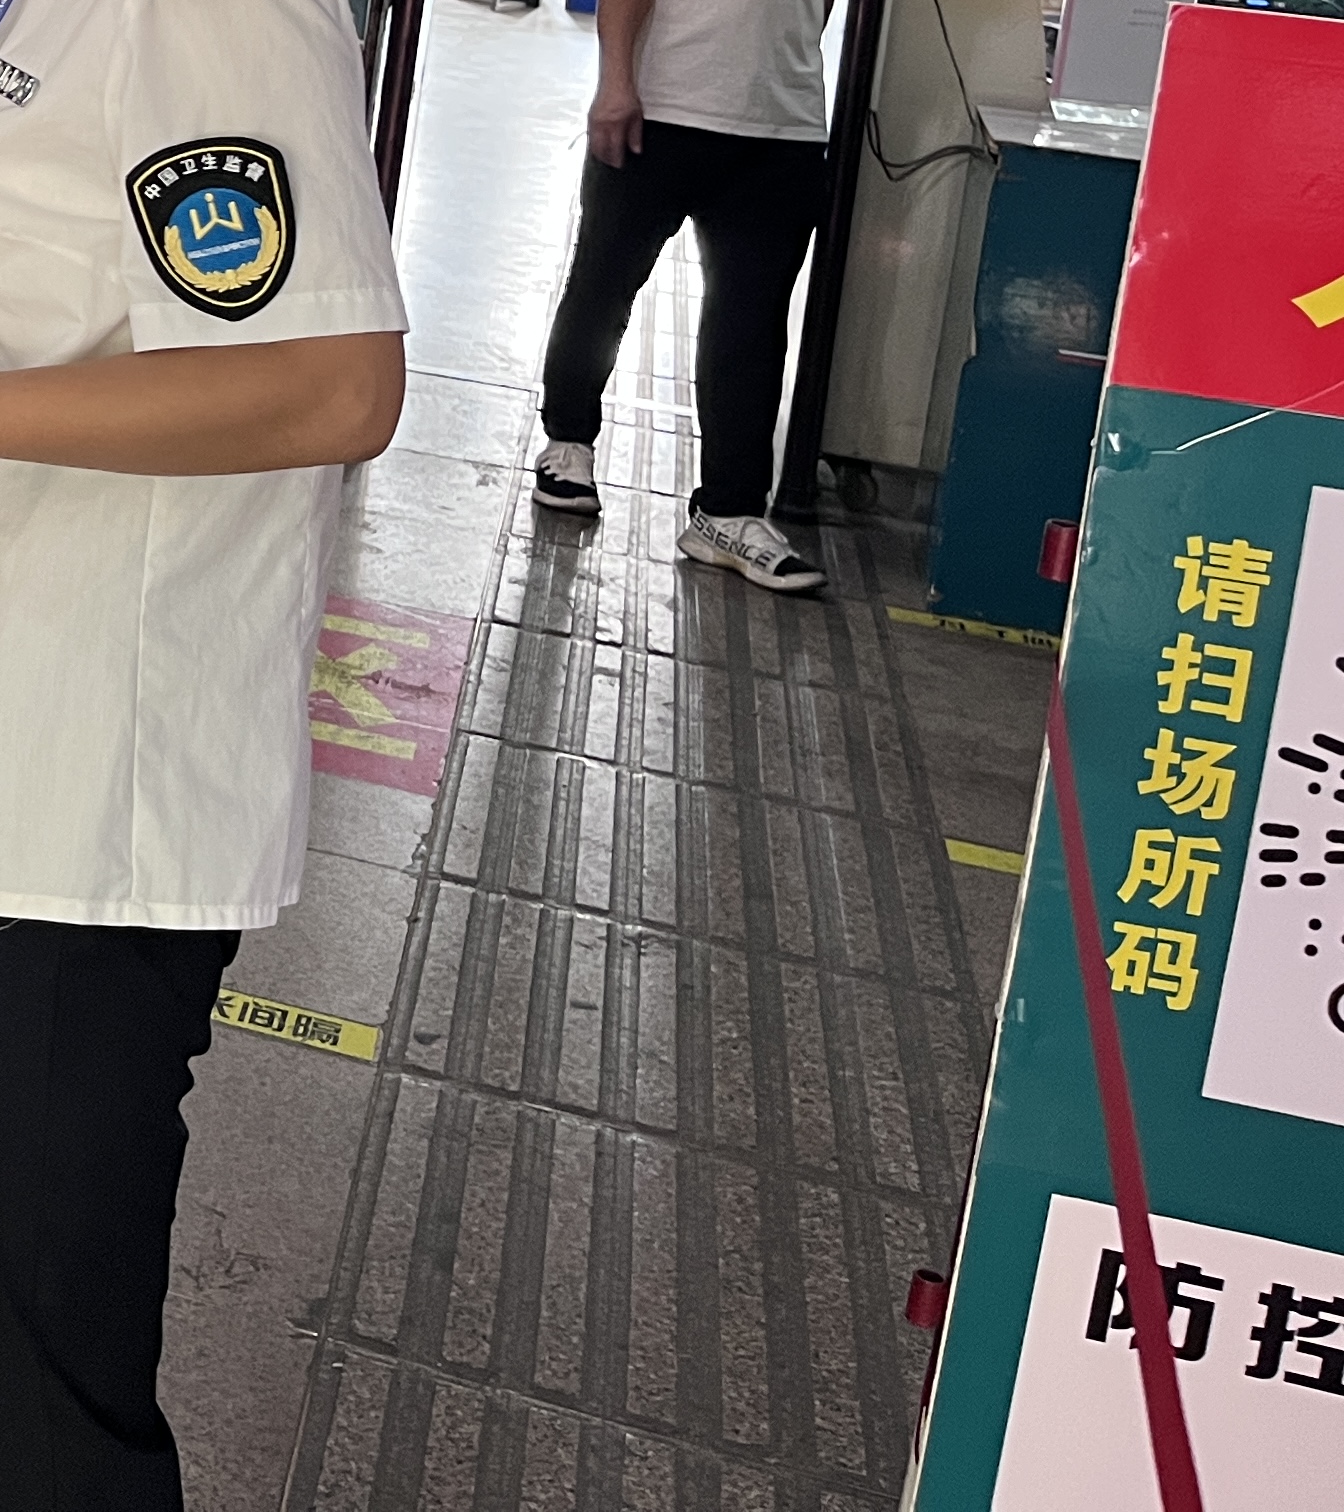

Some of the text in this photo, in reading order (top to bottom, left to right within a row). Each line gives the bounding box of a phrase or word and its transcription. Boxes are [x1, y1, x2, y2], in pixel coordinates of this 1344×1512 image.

[144, 152, 266, 200] 中国卫生监督
[1105, 535, 1273, 1010] 请扫场所码
